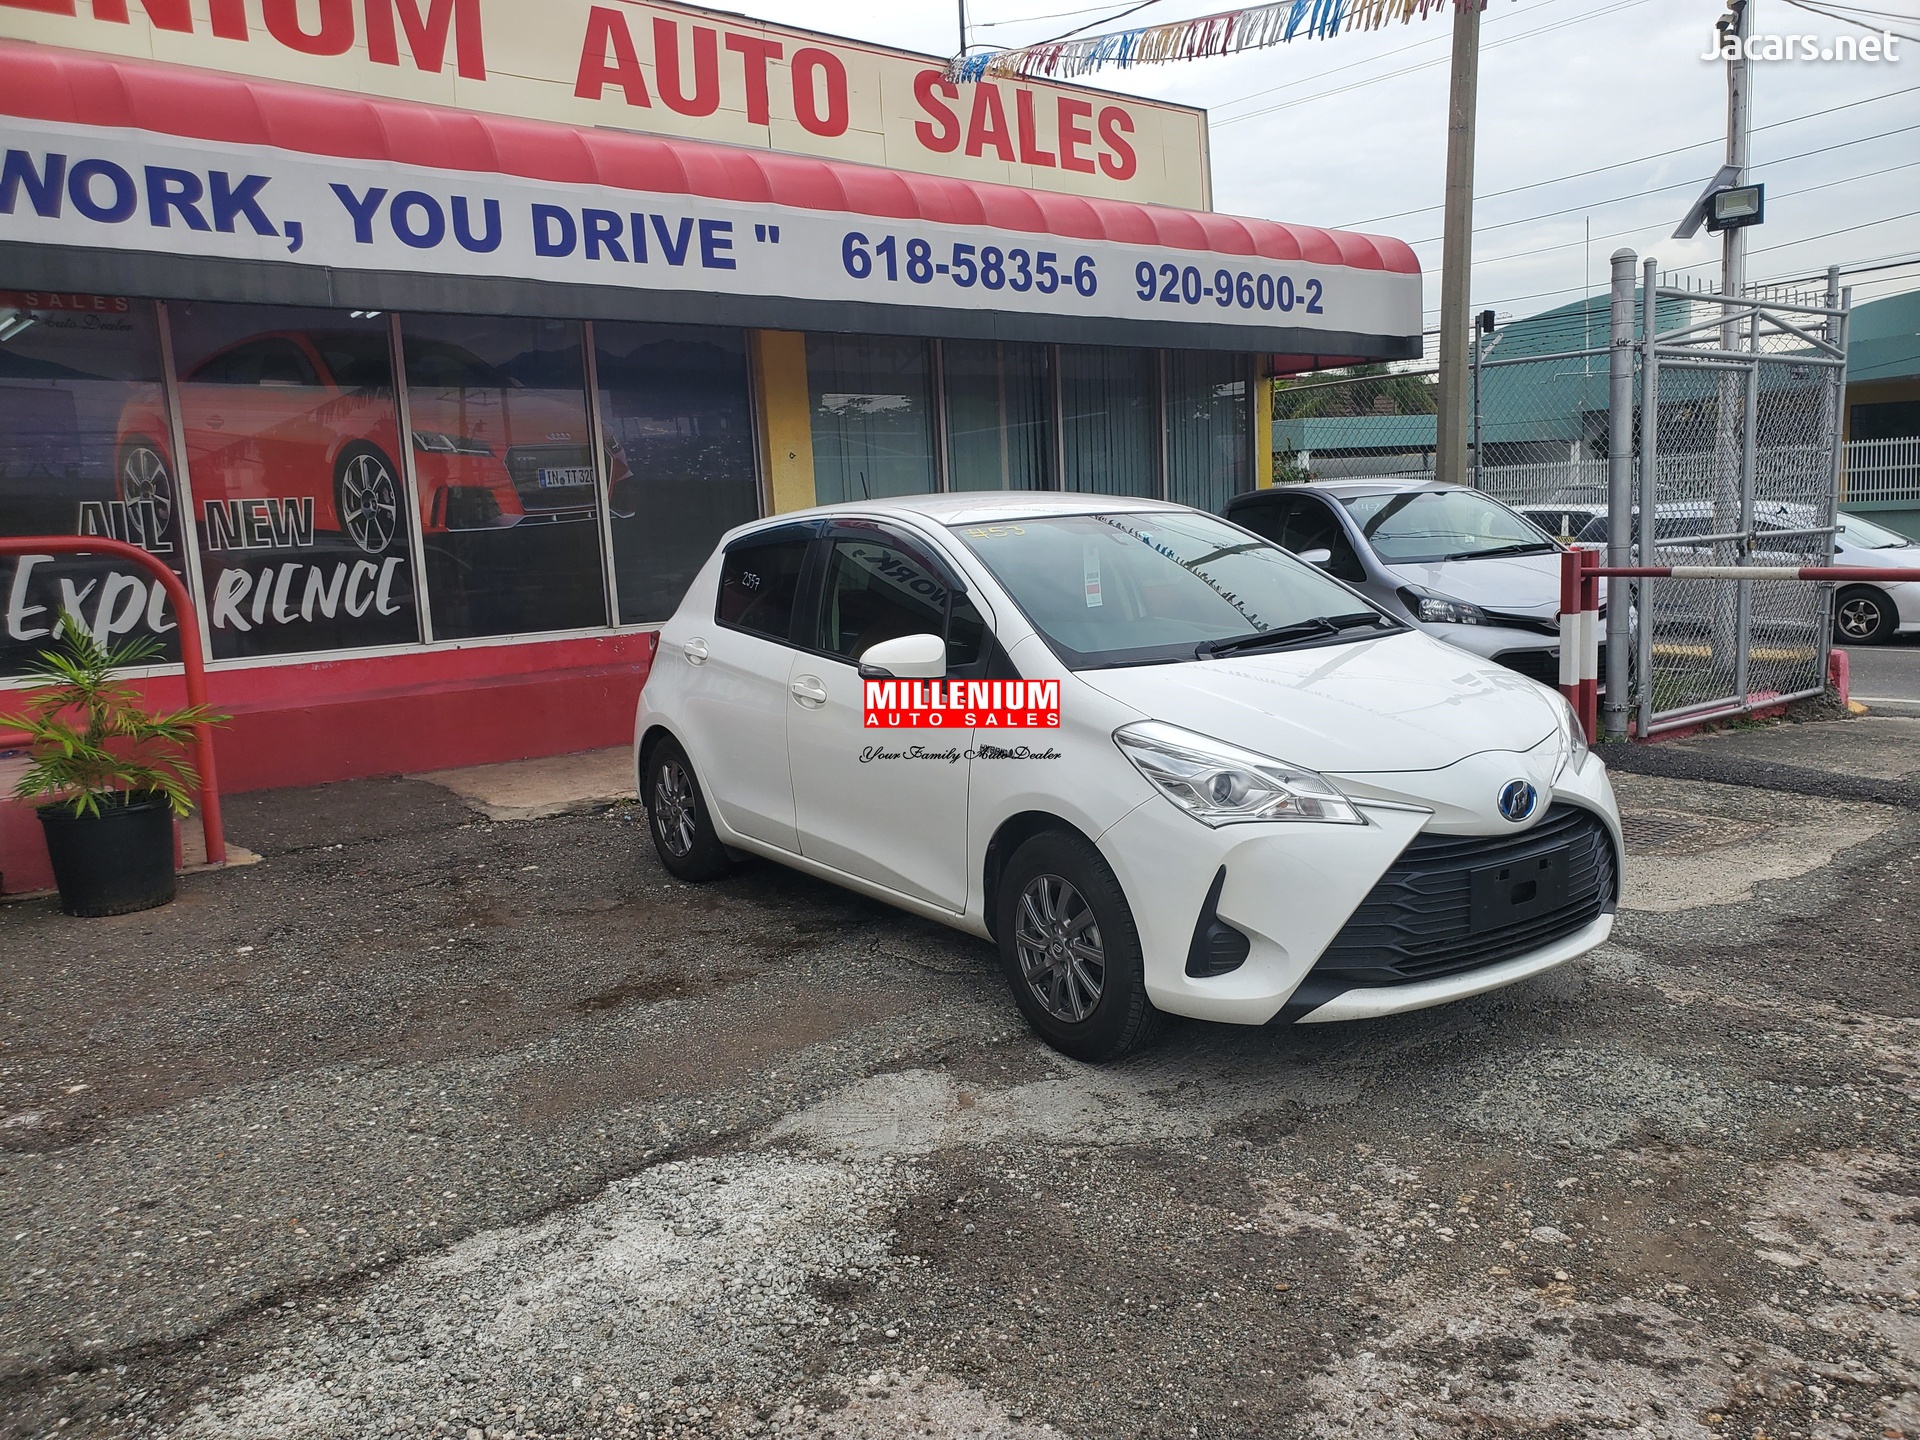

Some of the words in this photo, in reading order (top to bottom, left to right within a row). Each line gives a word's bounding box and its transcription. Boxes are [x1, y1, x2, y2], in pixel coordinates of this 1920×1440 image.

[574, 6, 850, 138] AUTO
[913, 69, 1137, 182] SALES
[330, 183, 502, 254] YOU
[531, 203, 738, 270] DRIVE
[841, 231, 1099, 297] 618-5835-6
[1135, 260, 1325, 315] 920-9600-2
[25, 292, 129, 311] SALES
[81, 313, 134, 332] Dealer
[77, 500, 174, 556] ALL
[203, 496, 316, 551] NEW
